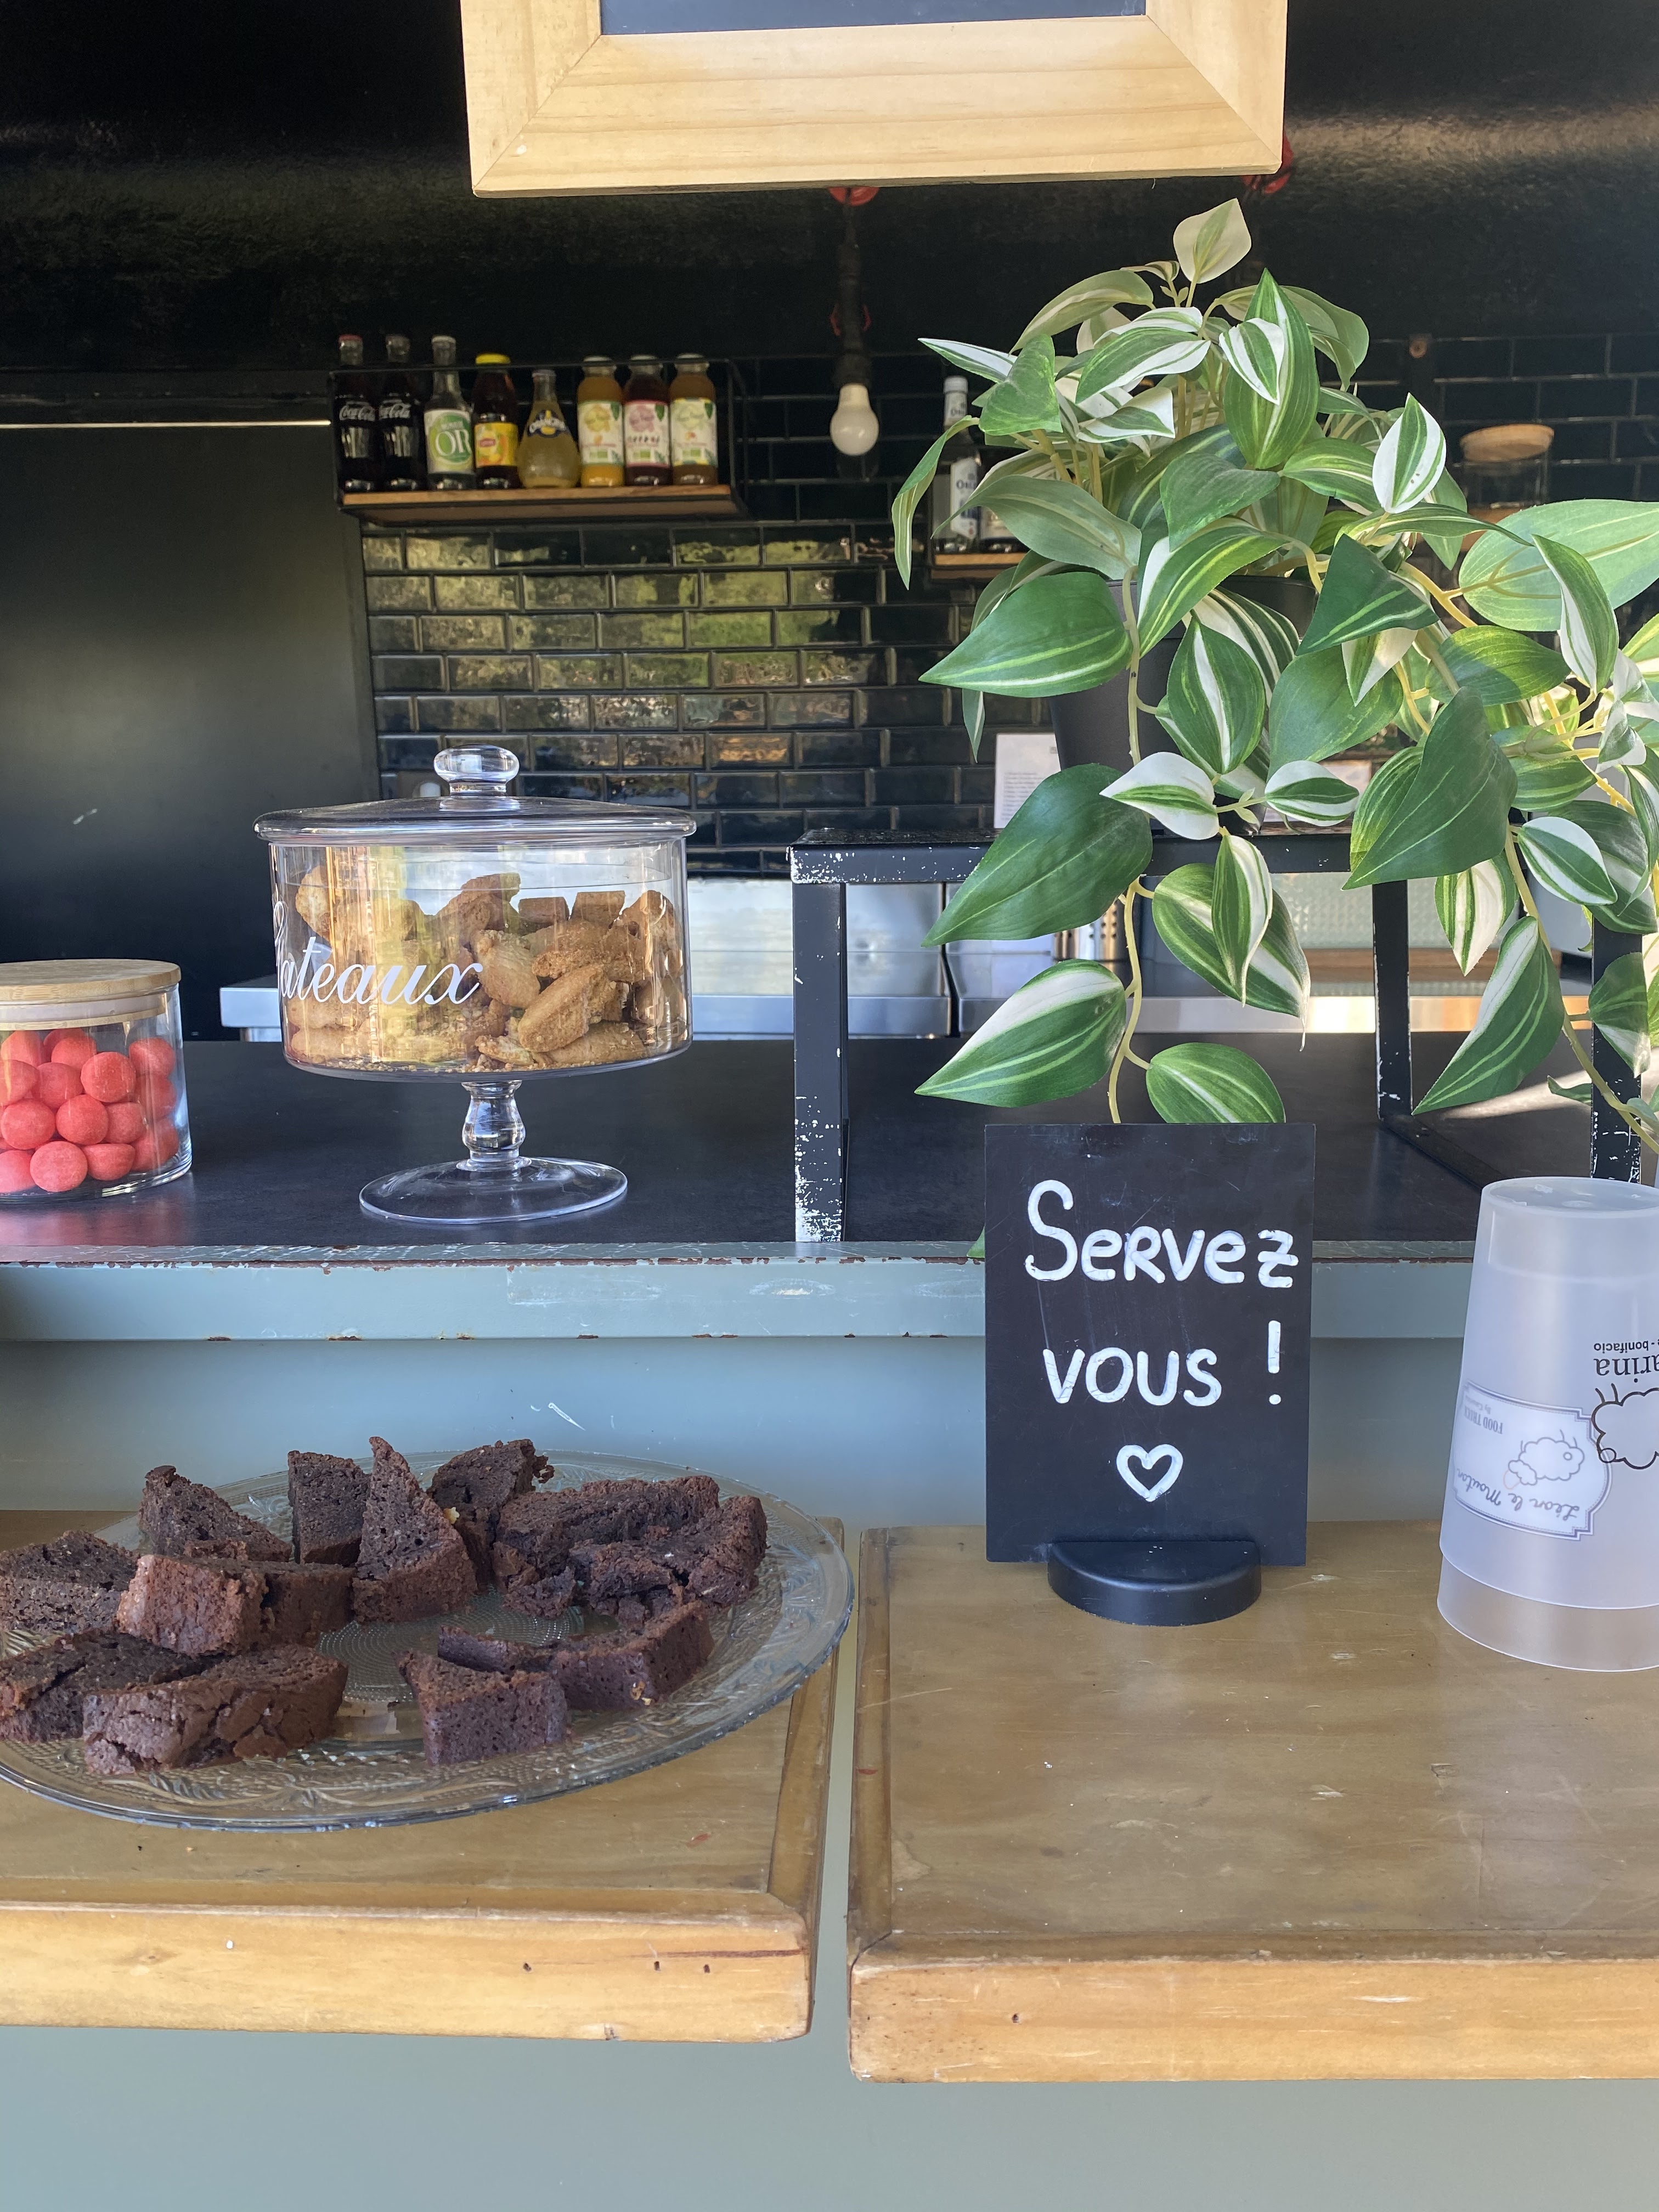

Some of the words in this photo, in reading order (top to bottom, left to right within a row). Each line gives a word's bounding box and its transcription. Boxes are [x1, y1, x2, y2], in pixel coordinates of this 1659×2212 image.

[1593, 1340, 1649, 1354] bonifacio
[1483, 1417, 1503, 1435] FOOD
[1457, 1468, 1502, 1506] Mouton
[1508, 1492, 1523, 1512] le
[1528, 1498, 1580, 1521] Léon
